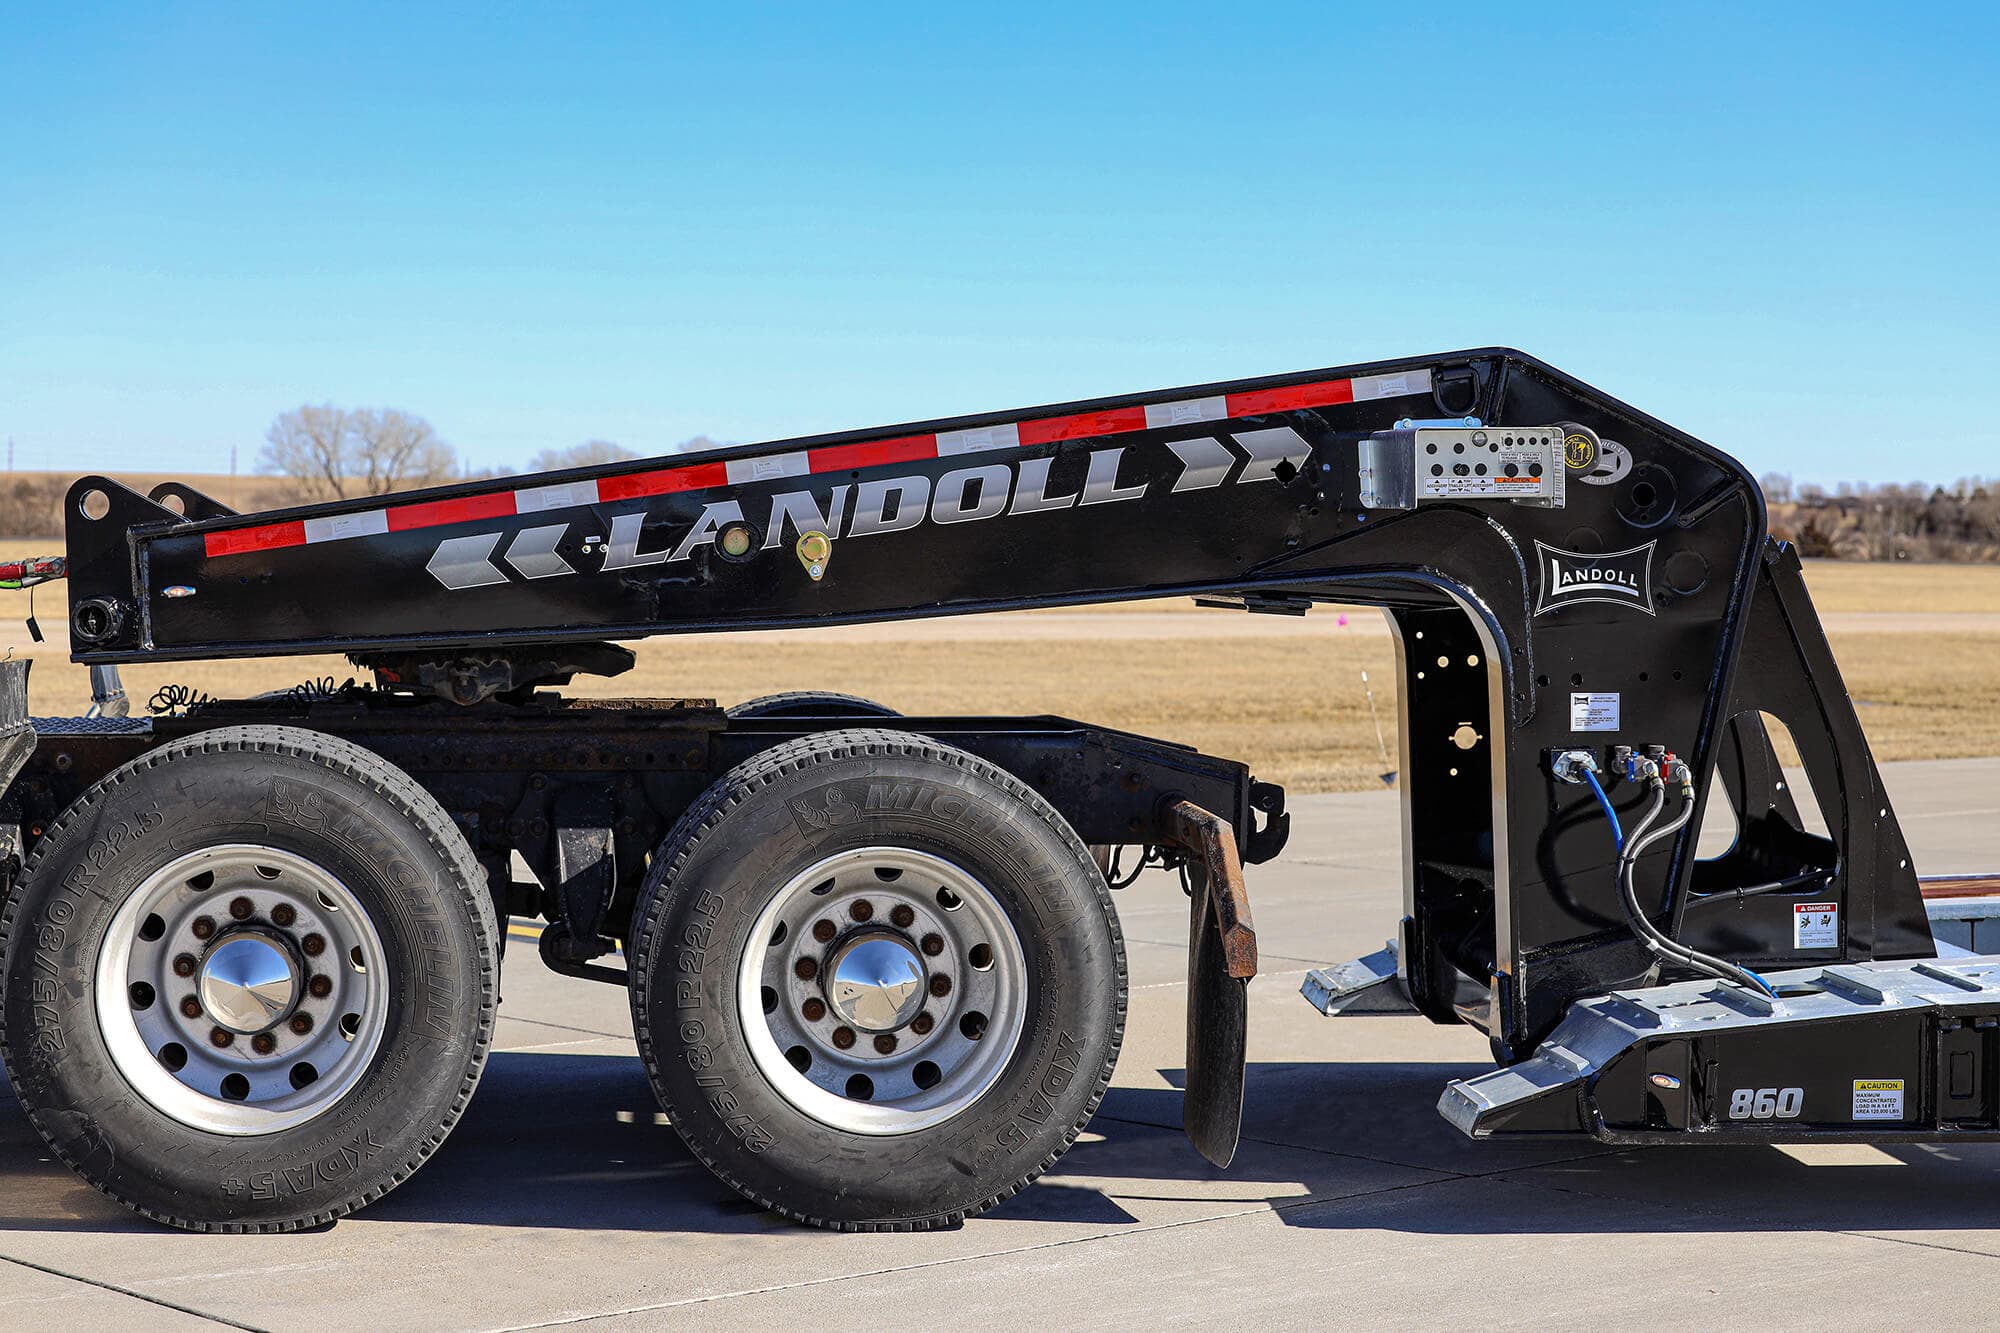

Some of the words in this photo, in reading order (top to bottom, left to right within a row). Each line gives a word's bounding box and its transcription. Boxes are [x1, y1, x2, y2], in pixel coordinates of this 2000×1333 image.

[600, 446, 1150, 571] LANDOLL
[1551, 558, 1640, 597] LANDOLL
[865, 783, 1075, 913] MICHELIN
[331, 812, 454, 1036] MICHELIN
[1728, 1088, 1804, 1120] 860
